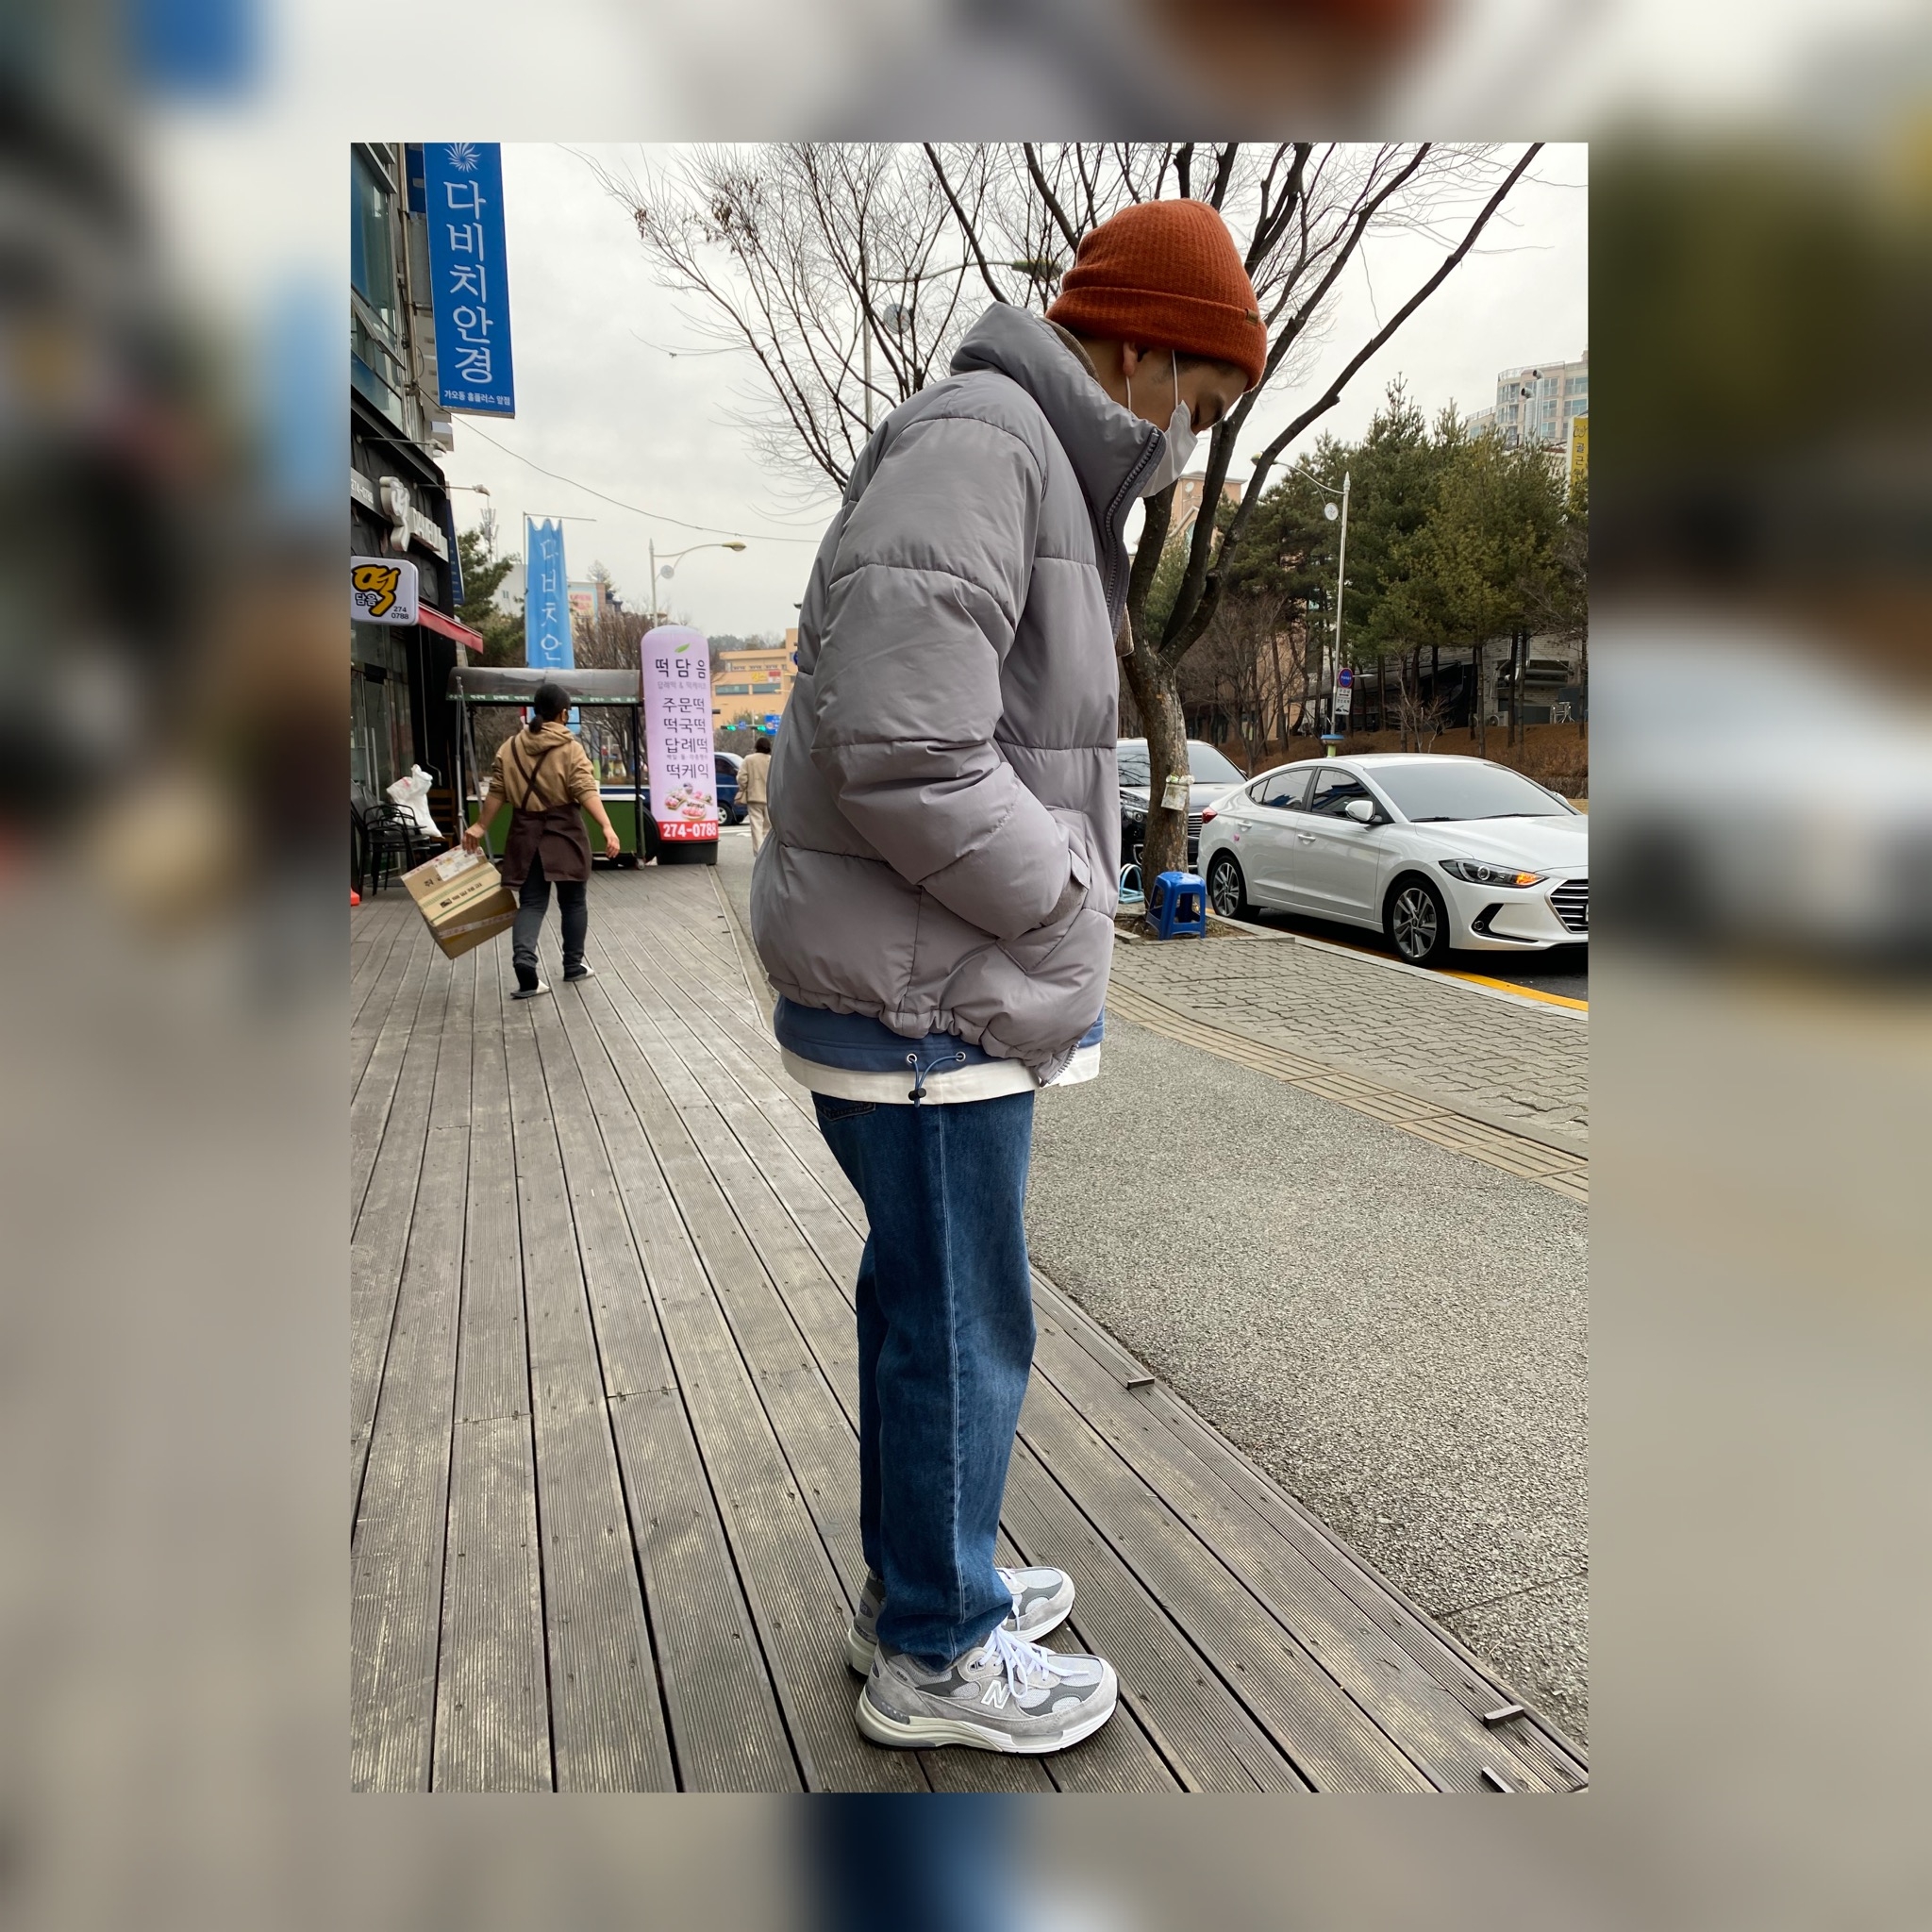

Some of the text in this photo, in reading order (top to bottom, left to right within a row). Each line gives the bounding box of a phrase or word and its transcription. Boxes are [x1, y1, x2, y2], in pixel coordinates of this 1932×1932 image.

[443, 179, 494, 384] 다비치안경
[443, 390, 466, 401] 가오동
[355, 592, 377, 607] 담음
[662, 698, 705, 713] 주문떡
[663, 718, 706, 734] 떡국떡
[665, 738, 708, 754] 답례떡
[666, 763, 709, 779] 떡케익
[662, 823, 718, 838] 274-0788
